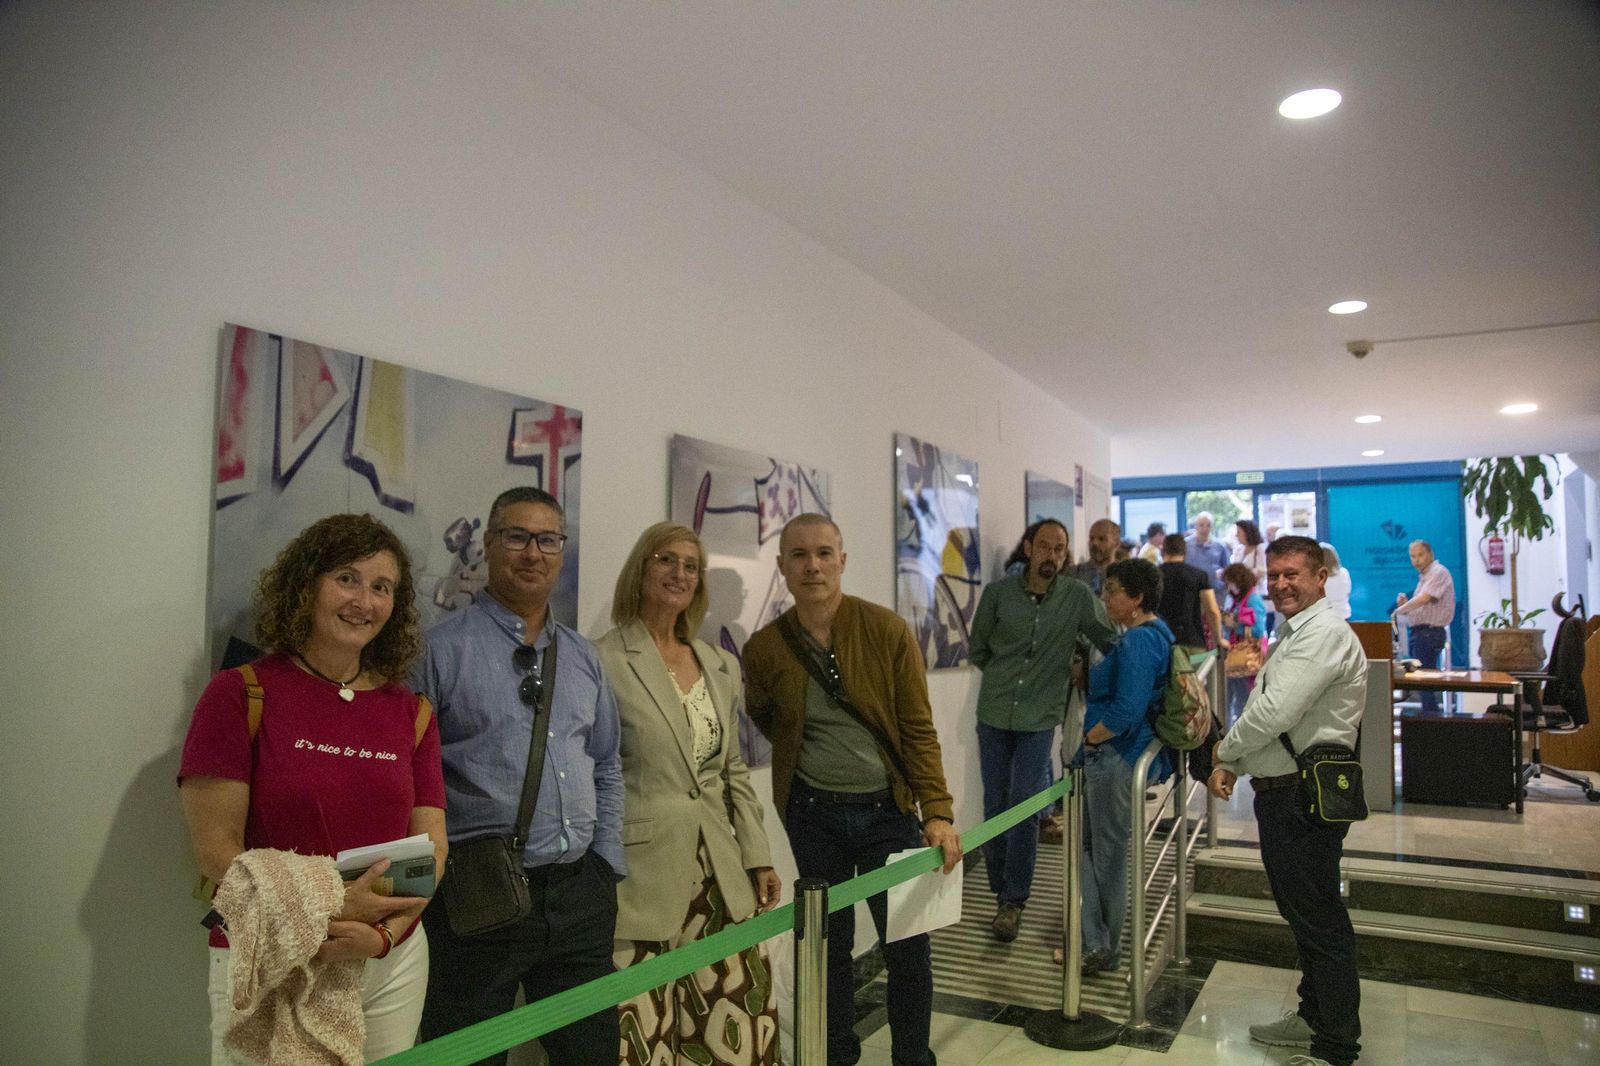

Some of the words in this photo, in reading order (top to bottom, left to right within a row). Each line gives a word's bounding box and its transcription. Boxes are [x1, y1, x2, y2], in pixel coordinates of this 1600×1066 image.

[294, 738, 315, 750] it's
[316, 743, 341, 755] nice
[343, 746, 357, 757] to
[358, 748, 373, 758] be
[374, 750, 398, 761] nice
